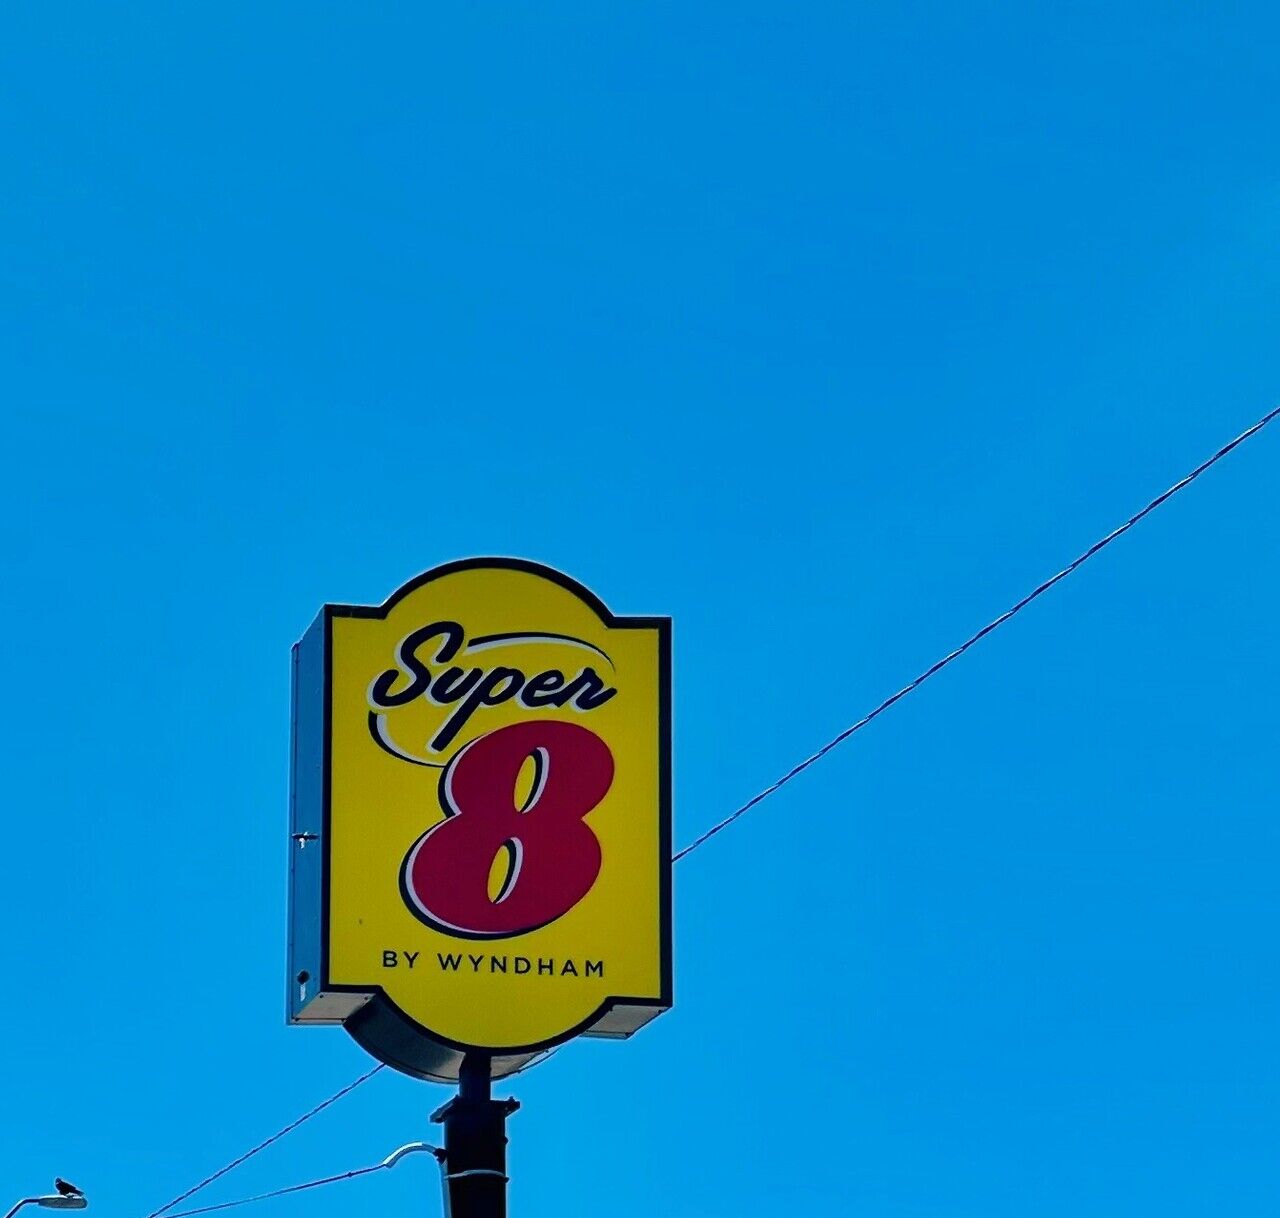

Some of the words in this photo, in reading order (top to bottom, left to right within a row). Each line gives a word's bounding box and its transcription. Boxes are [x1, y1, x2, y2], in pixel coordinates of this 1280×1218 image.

[368, 621, 618, 752] Super
[399, 720, 615, 940] 8
[382, 950, 419, 969] BY
[437, 952, 605, 978] WYNDHAM
